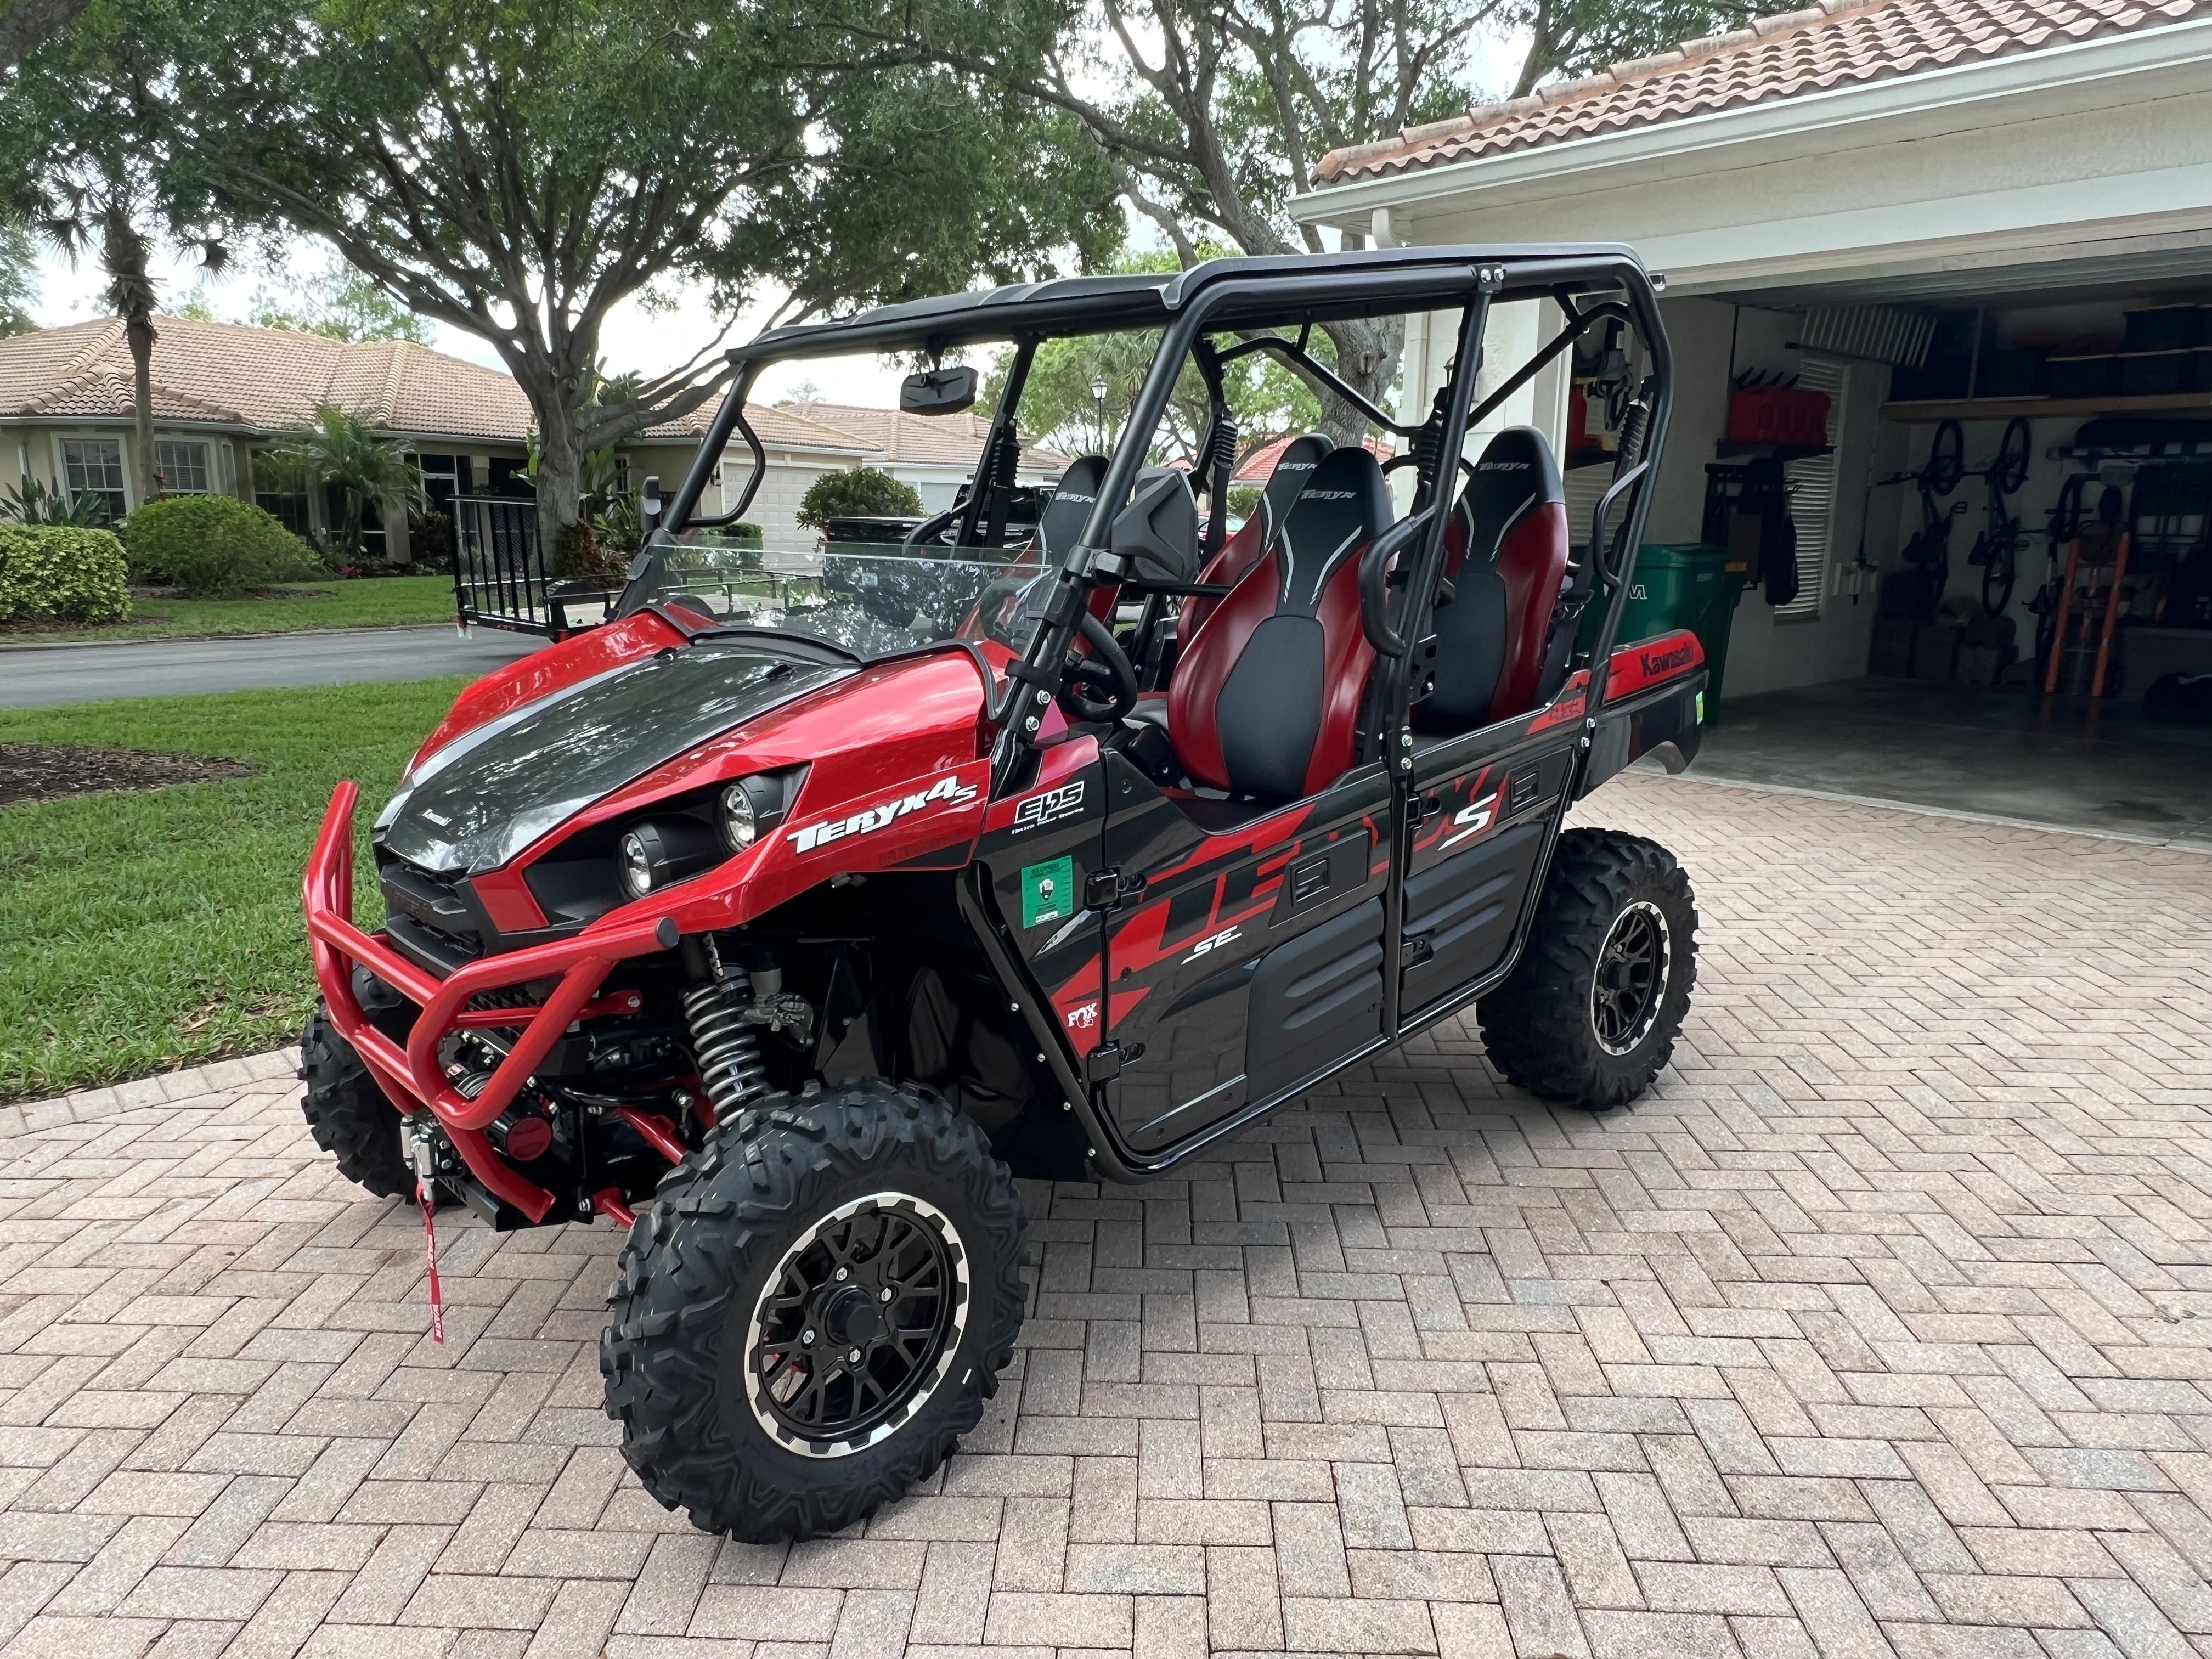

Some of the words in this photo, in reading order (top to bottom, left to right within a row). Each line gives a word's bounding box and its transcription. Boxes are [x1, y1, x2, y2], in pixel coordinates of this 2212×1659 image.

[1014, 780, 1085, 824] EPS
[1437, 792, 1497, 851] S
[1181, 924, 1243, 966] SE
[1067, 1002, 1098, 1028] FOX
